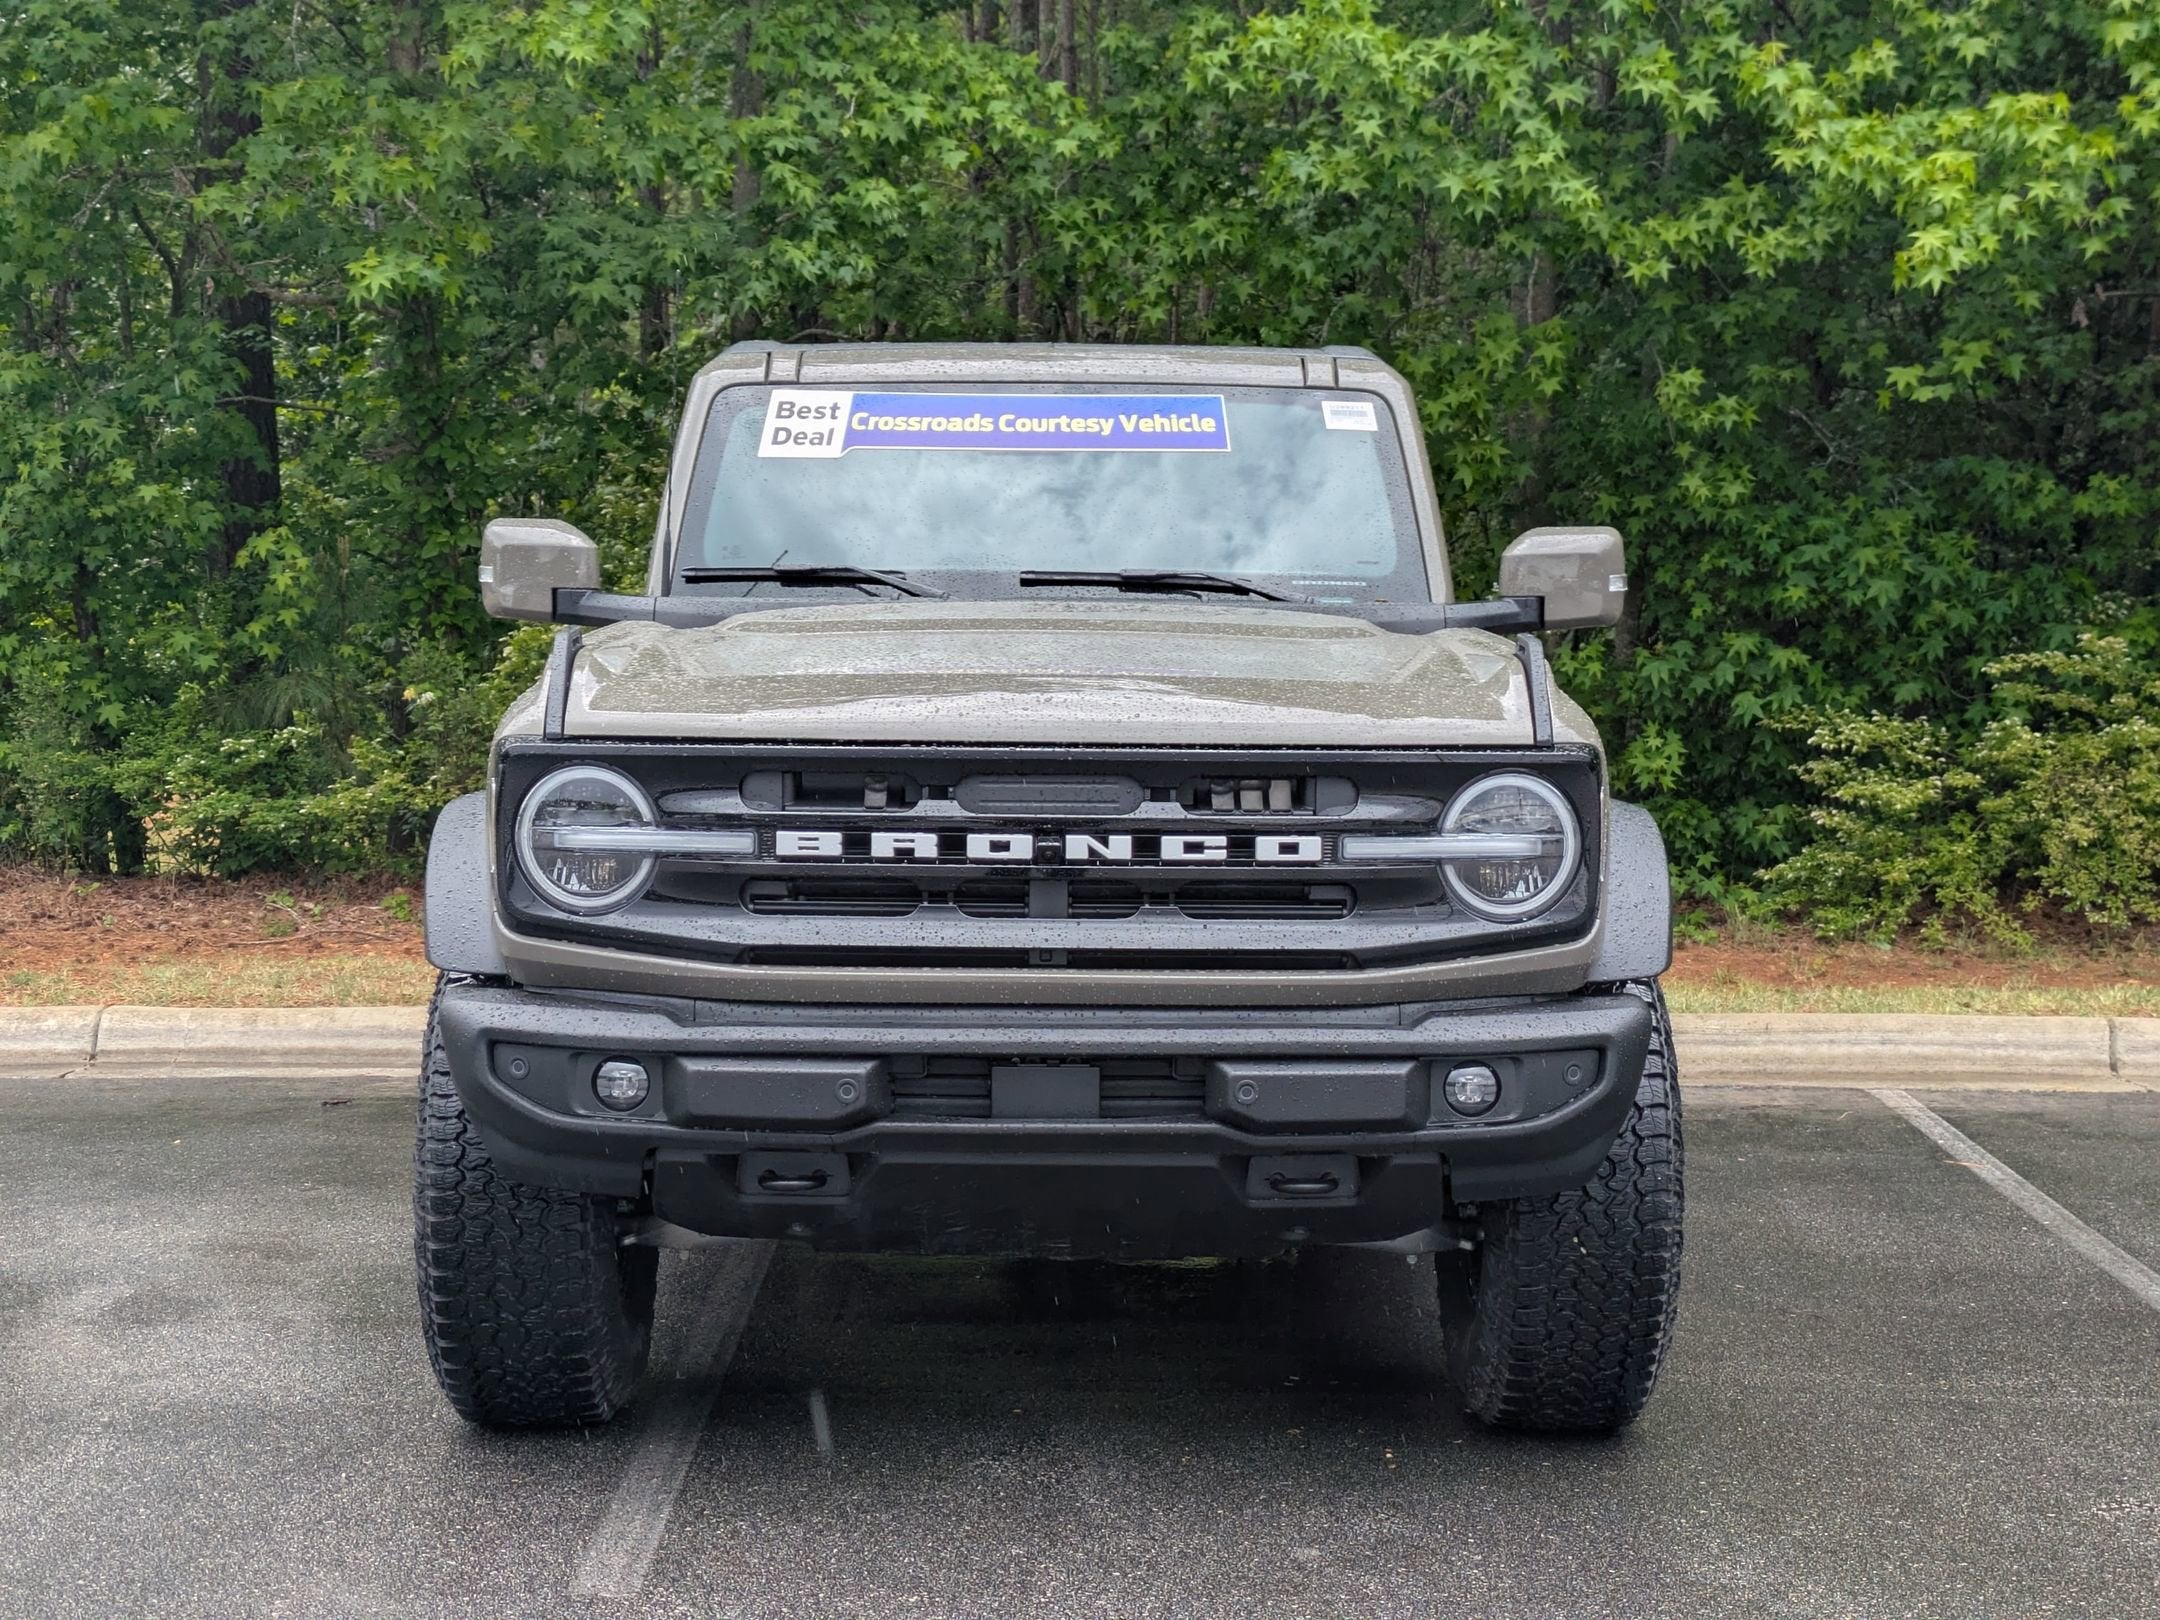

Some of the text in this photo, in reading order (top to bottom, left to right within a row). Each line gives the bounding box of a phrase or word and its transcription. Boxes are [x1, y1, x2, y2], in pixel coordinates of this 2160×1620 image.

[775, 400, 840, 420] Best
[851, 412, 1217, 436] Crossroads Courtesy Vehicle
[771, 426, 834, 446] Deal
[776, 830, 1322, 861] BRONCO
